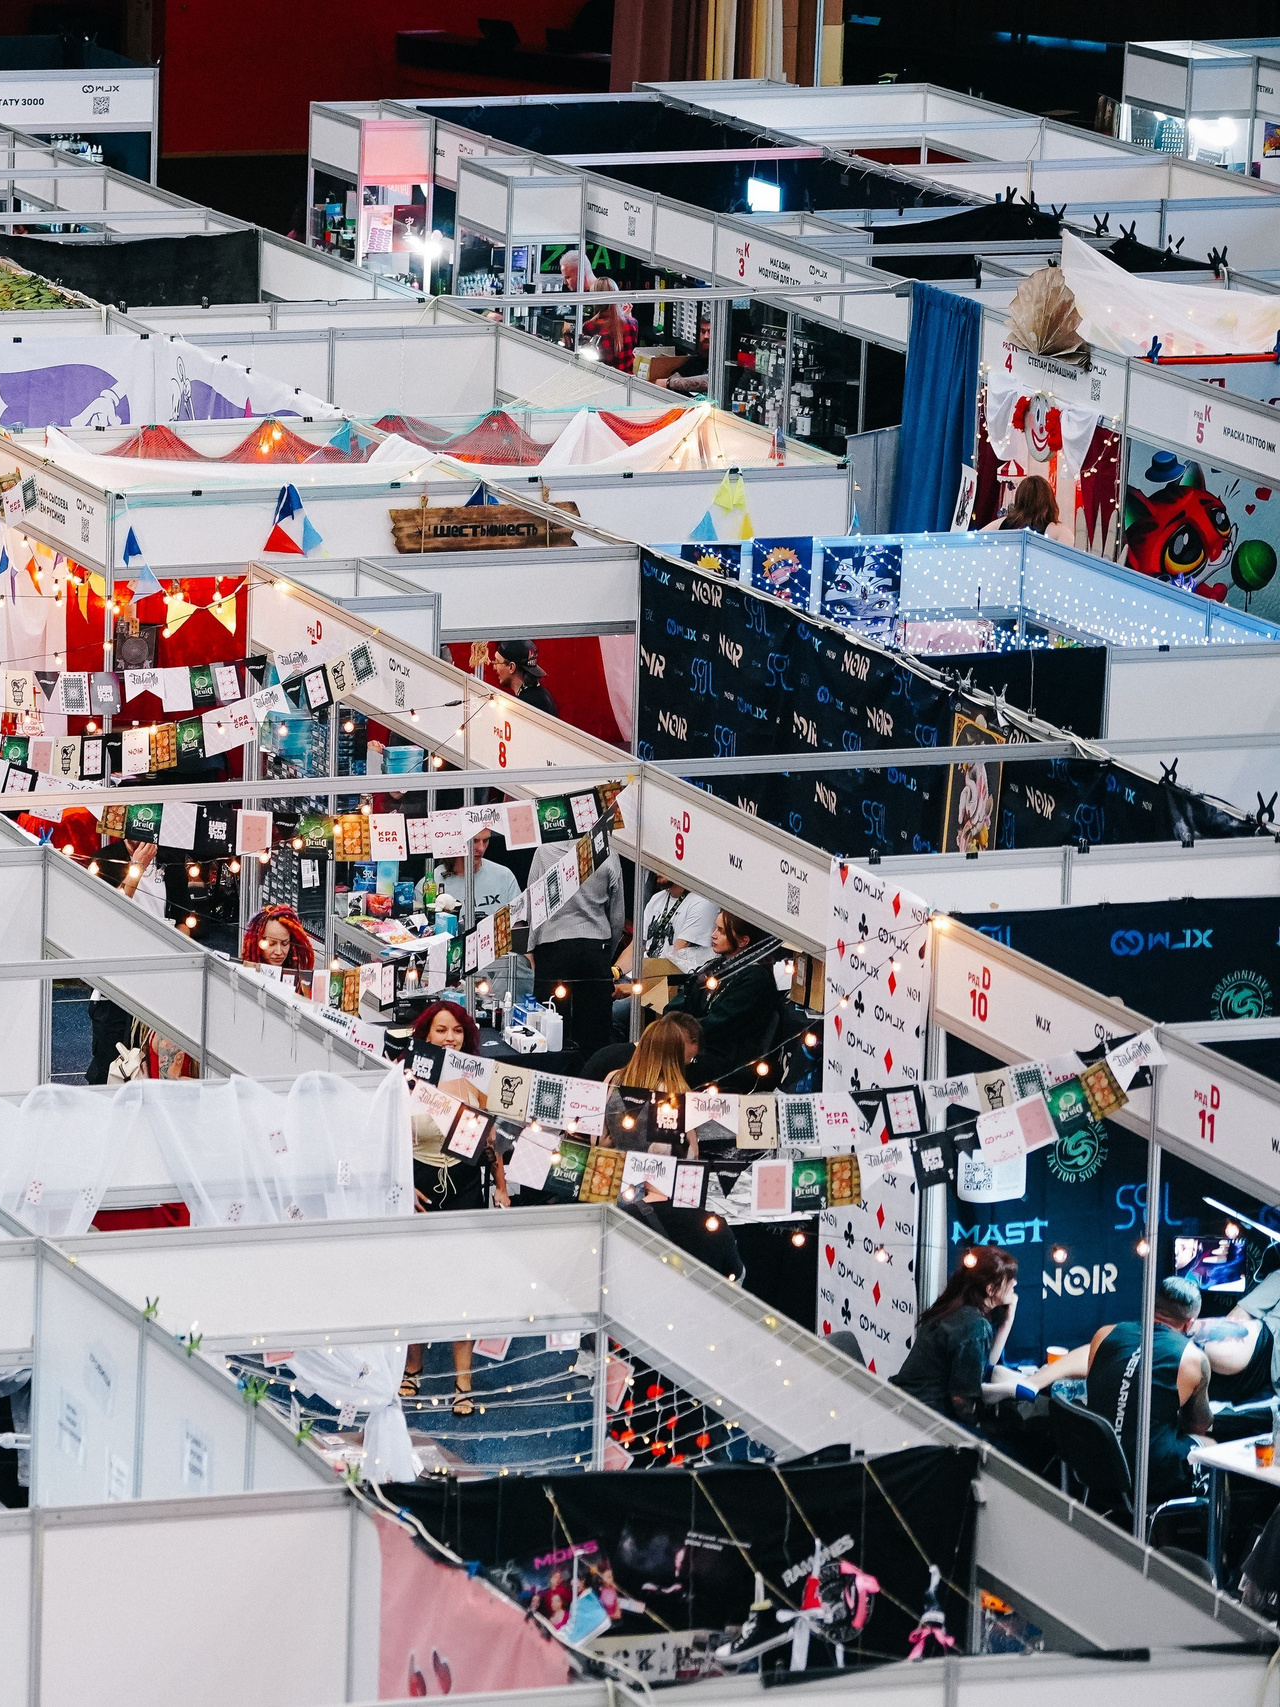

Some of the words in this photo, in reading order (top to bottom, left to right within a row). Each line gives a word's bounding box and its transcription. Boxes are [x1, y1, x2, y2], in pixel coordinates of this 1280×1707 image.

[21, 97, 45, 107] 3000
[738, 257, 745, 277] 3
[758, 266, 780, 281] МОДУЛЕЙ
[779, 274, 790, 285] ДЛЯ
[769, 257, 791, 273] МАГАЗИН
[1004, 353, 1013, 373] 4
[1027, 356, 1047, 374] СТЕПАН
[1047, 362, 1078, 382] ДОМАШНИЙ
[1193, 410, 1203, 421] РЯД
[1196, 423, 1205, 444] 5
[1223, 426, 1245, 446] КРАСКА
[1244, 429, 1266, 451] TATTOO
[1266, 440, 1276, 454] INK
[48, 488, 69, 511] СЫСОЕВА
[45, 505, 66, 526] РУСИНОВ
[691, 580, 723, 608] NOIR
[307, 625, 316, 639] РЯД
[316, 620, 322, 640] D
[841, 650, 870, 681] NOIR
[493, 726, 503, 740] РЯД
[505, 720, 511, 742] D
[657, 710, 688, 742] NOIR
[866, 706, 893, 737] NOIR
[128, 748, 144, 756] NOIR
[498, 742, 506, 768] 8
[814, 781, 837, 816] NOIR
[1025, 785, 1056, 821] NOIR
[133, 820, 155, 831] Druid
[543, 819, 566, 829] Druid
[670, 816, 681, 832] РЯД
[682, 811, 691, 833] D
[305, 836, 328, 848] Druid
[675, 833, 684, 860] 9
[728, 853, 743, 871] WJX
[968, 971, 980, 989] РЯД
[982, 966, 991, 990] D
[969, 989, 988, 1022] 10
[1035, 1014, 1051, 1034] WJX
[353, 1038, 375, 1049] КРА
[1194, 1089, 1208, 1107] РЯД
[1210, 1084, 1221, 1110] D
[1198, 1109, 1216, 1143] 11
[552, 1168, 578, 1182] Druid
[1047, 1152, 1076, 1183] TATTOO
[1079, 1148, 1109, 1182] SUPPLY
[795, 1185, 820, 1196] Druid
[951, 1216, 1048, 1246] MAST
[1042, 1263, 1117, 1299] NOIR
